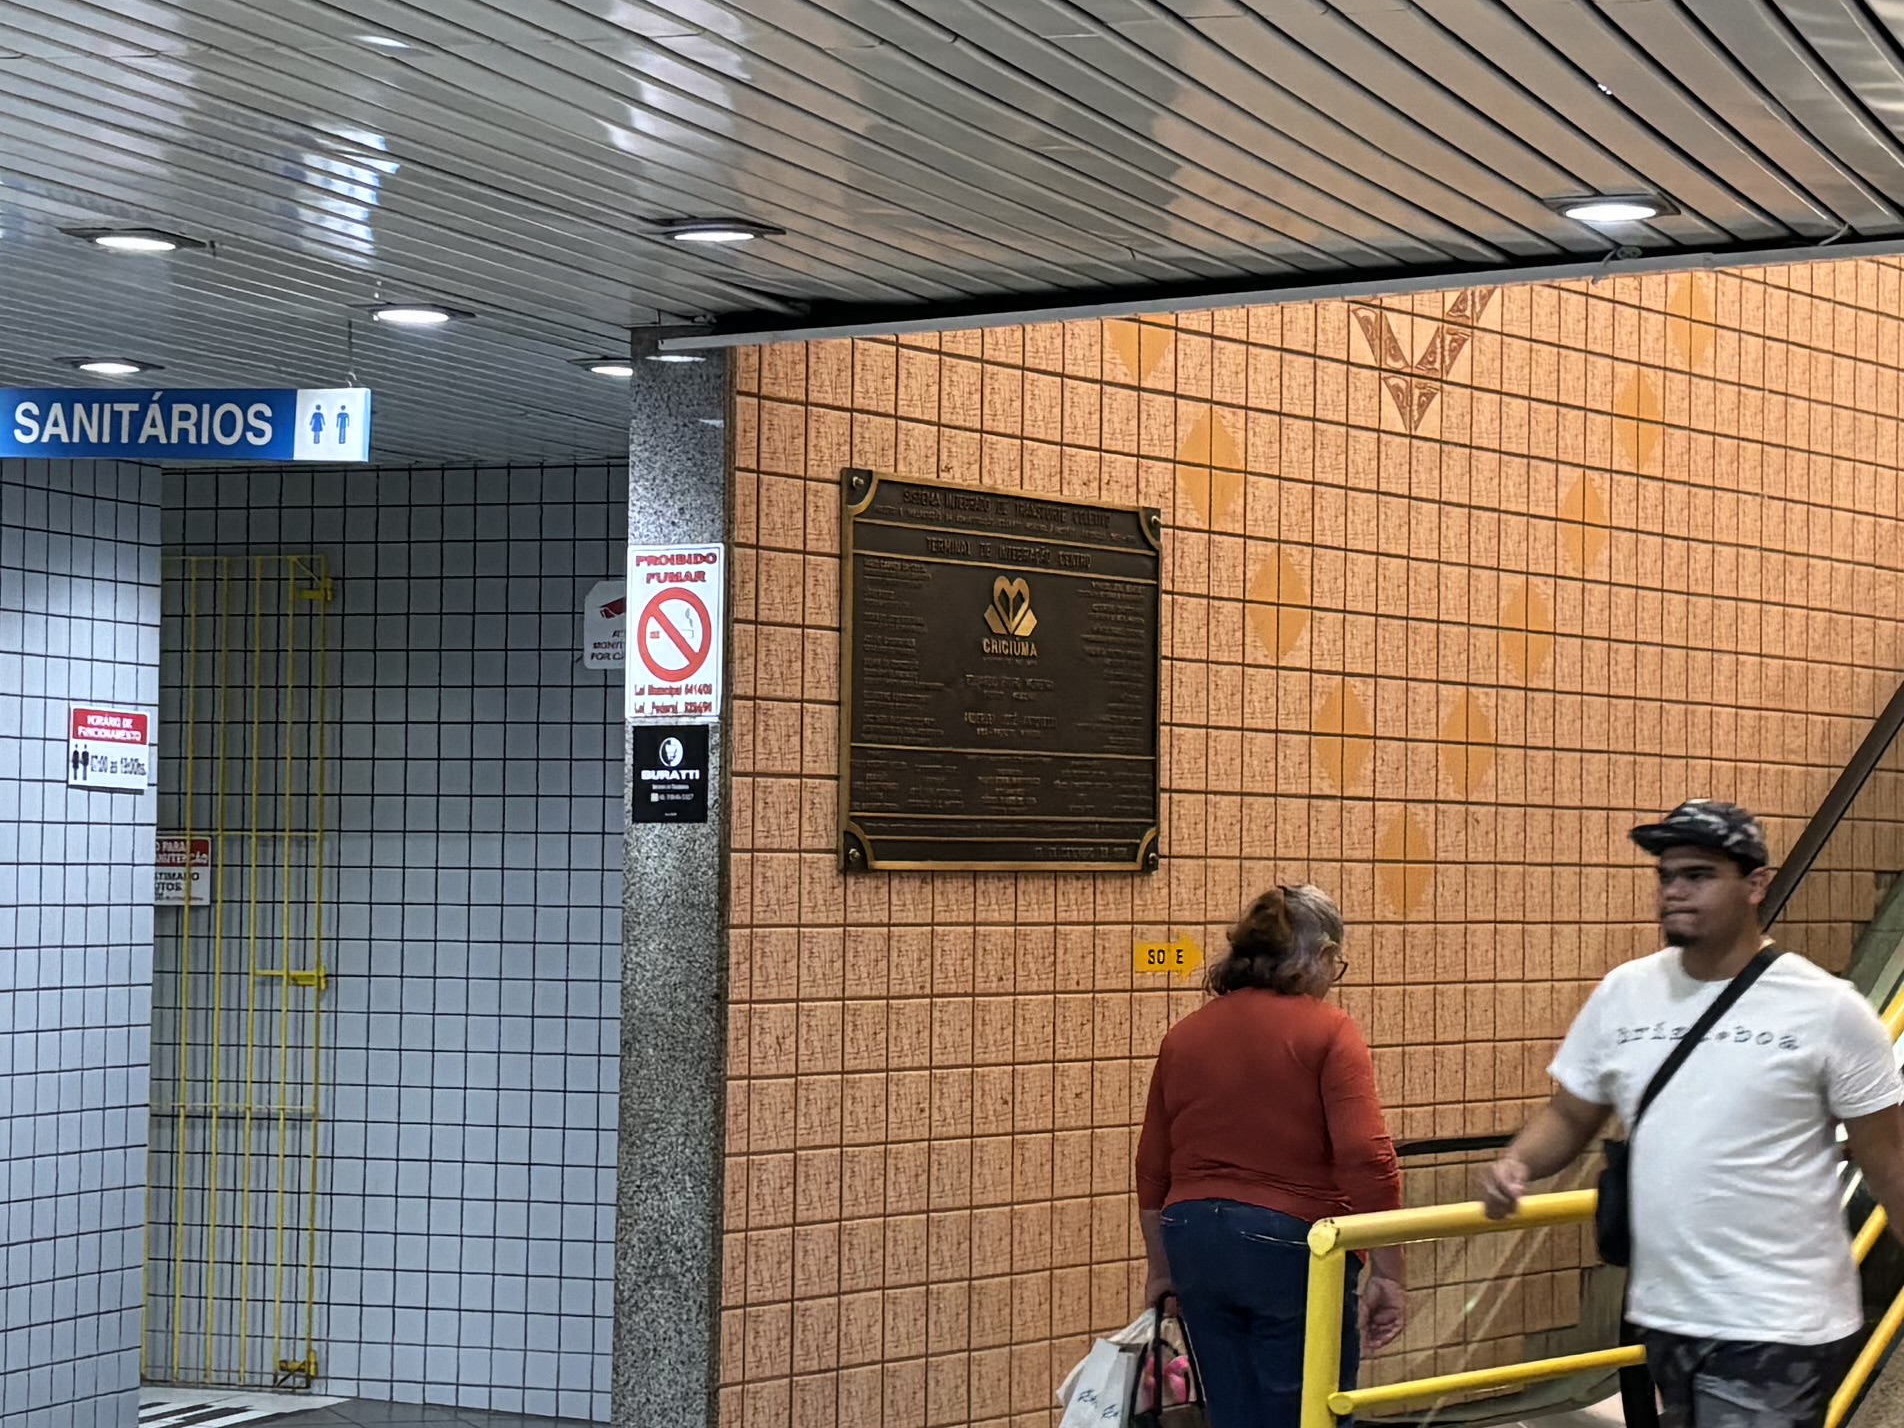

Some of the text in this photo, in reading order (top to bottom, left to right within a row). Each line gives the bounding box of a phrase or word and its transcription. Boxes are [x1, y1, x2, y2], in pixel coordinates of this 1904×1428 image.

[13, 391, 274, 446] SANITÁRIOS
[635, 552, 717, 567] PROIBIDO
[926, 536, 1092, 569] TERMINAL DE INTEGRAÇÃO CENTRO
[646, 571, 707, 584] FUMAR
[982, 637, 1037, 657] CRICIÚMA
[87, 713, 134, 729] HORÁRIO DE
[641, 769, 700, 780] BURATTI
